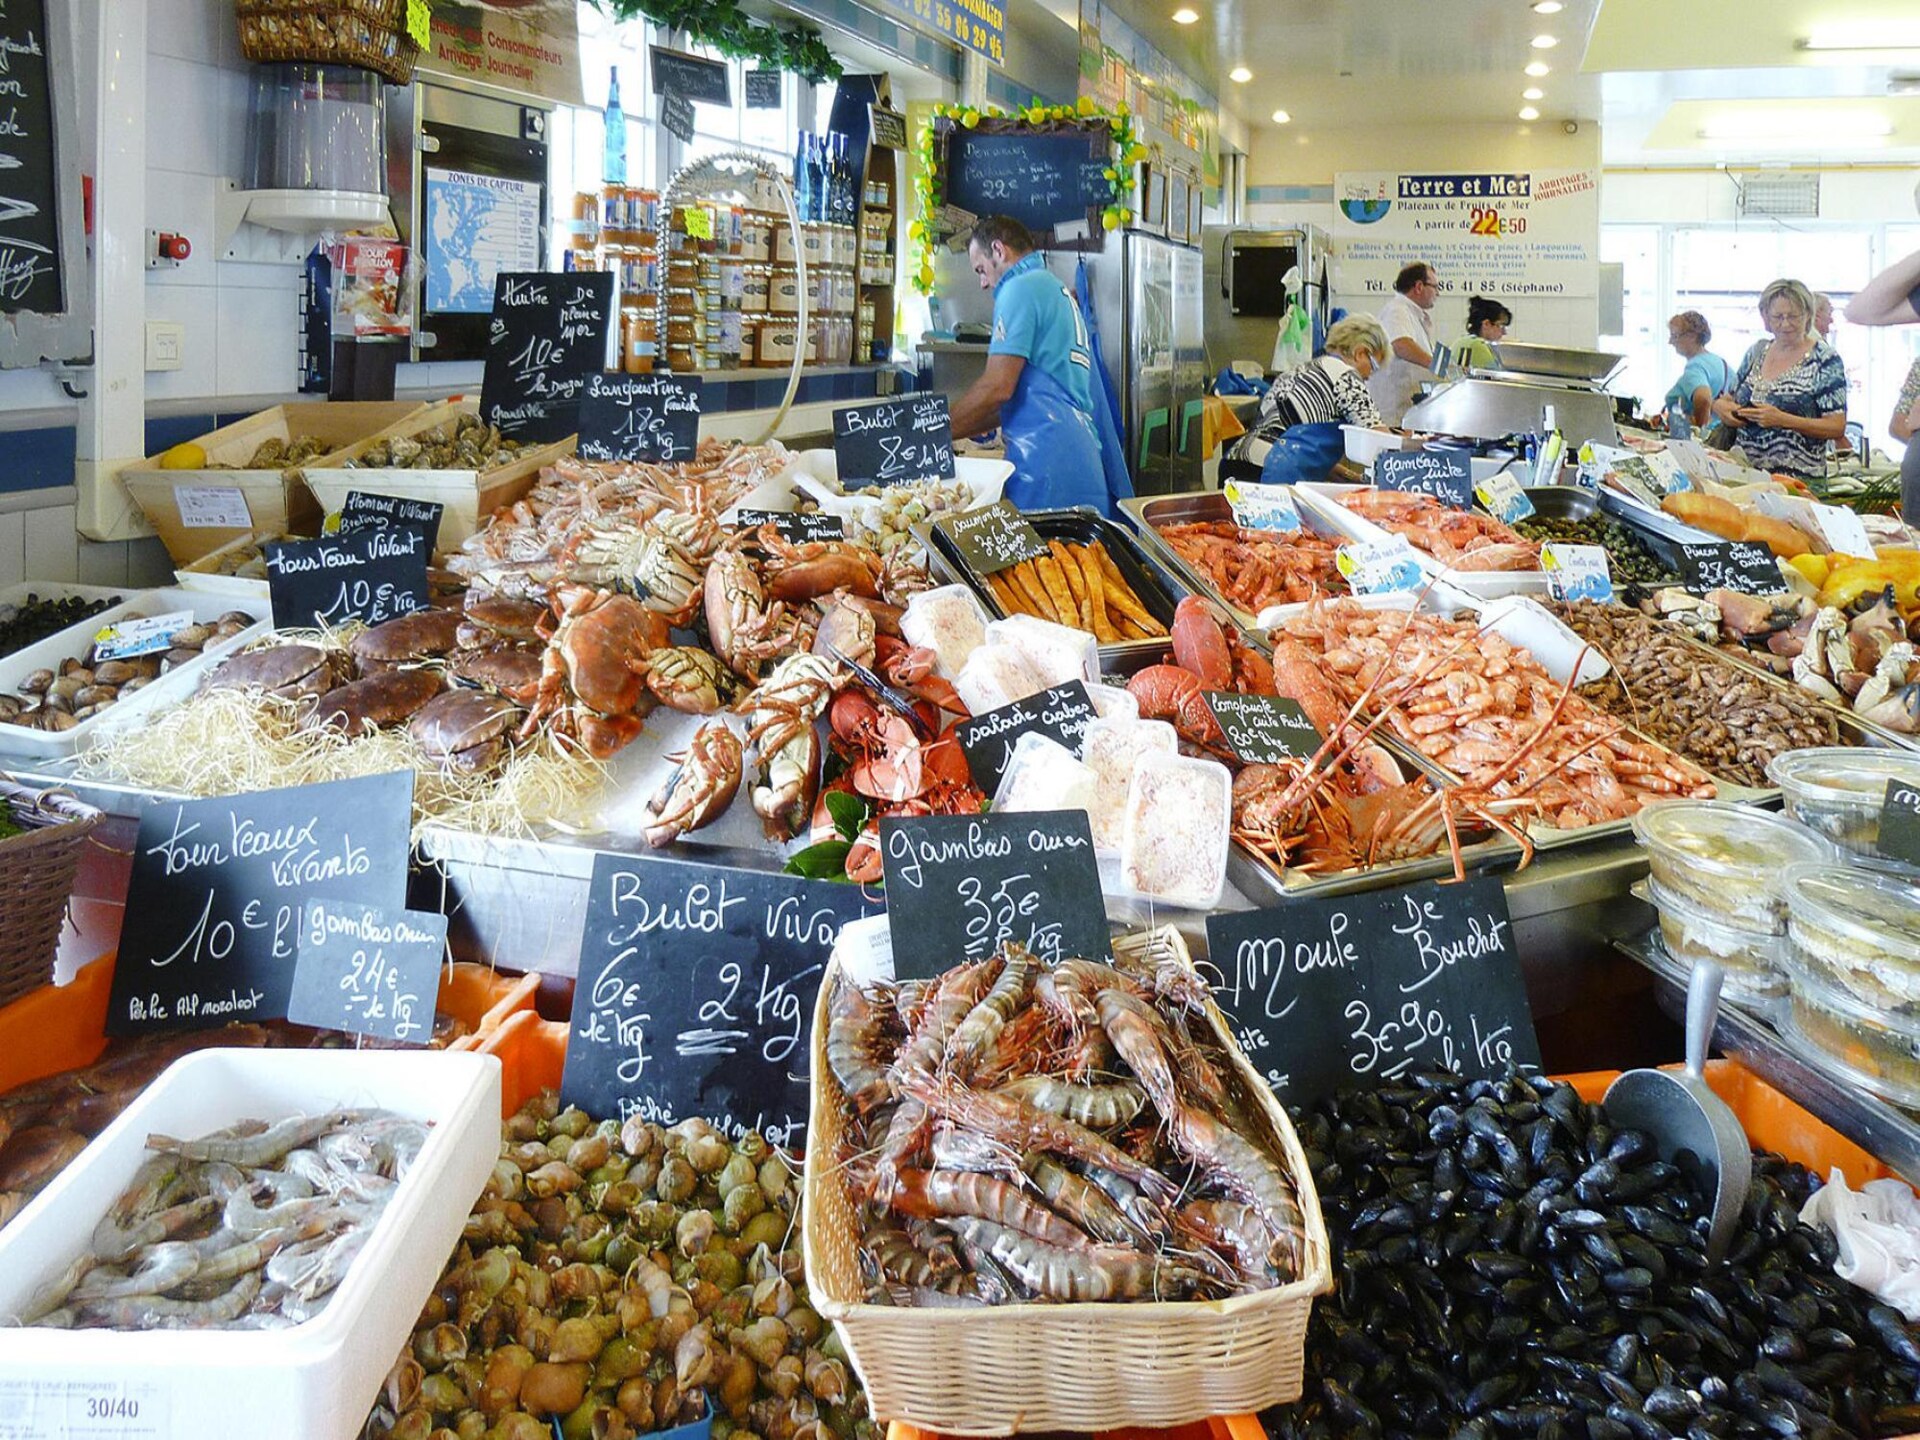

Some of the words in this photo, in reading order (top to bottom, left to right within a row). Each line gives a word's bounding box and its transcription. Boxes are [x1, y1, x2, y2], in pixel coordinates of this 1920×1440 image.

[438, 43, 482, 72] Arrivage
[486, 56, 534, 81] Journalier
[487, 31, 563, 66] Consommateurs
[448, 173, 475, 185] ZONES
[477, 177, 488, 187] DE
[489, 180, 525, 192] CAPTURE
[1400, 177, 1455, 196] Terre
[1463, 179, 1482, 195] et
[1489, 175, 1530, 195] Mer
[1533, 182, 1595, 202] JOURNALIERS
[1538, 173, 1588, 191] ARRIVAGES
[1397, 200, 1440, 211] Plateaux
[1444, 200, 1456, 211] de
[1460, 200, 1491, 211] Fruits
[1494, 200, 1508, 211] de
[1512, 200, 1530, 210] Mer
[1414, 219, 1421, 230] A
[1425, 219, 1455, 231] partir
[1459, 219, 1471, 230] de
[1365, 279, 1386, 292] Tél.
[1480, 280, 1496, 292] 85
[1501, 281, 1564, 294] (Stéphane)
[507, 335, 564, 369] 10€
[1383, 453, 1440, 484] gambas
[889, 822, 1012, 889] gambas
[607, 872, 747, 946] Bulot
[766, 894, 838, 947] Viva
[957, 873, 1041, 938] 35€
[310, 905, 392, 946] gambas
[1233, 912, 1359, 1019] Moule
[1398, 913, 1508, 993] Bouchot
[592, 947, 642, 1009] 6€
[698, 962, 739, 1022] 2
[87, 1398, 139, 1419] 30/40
